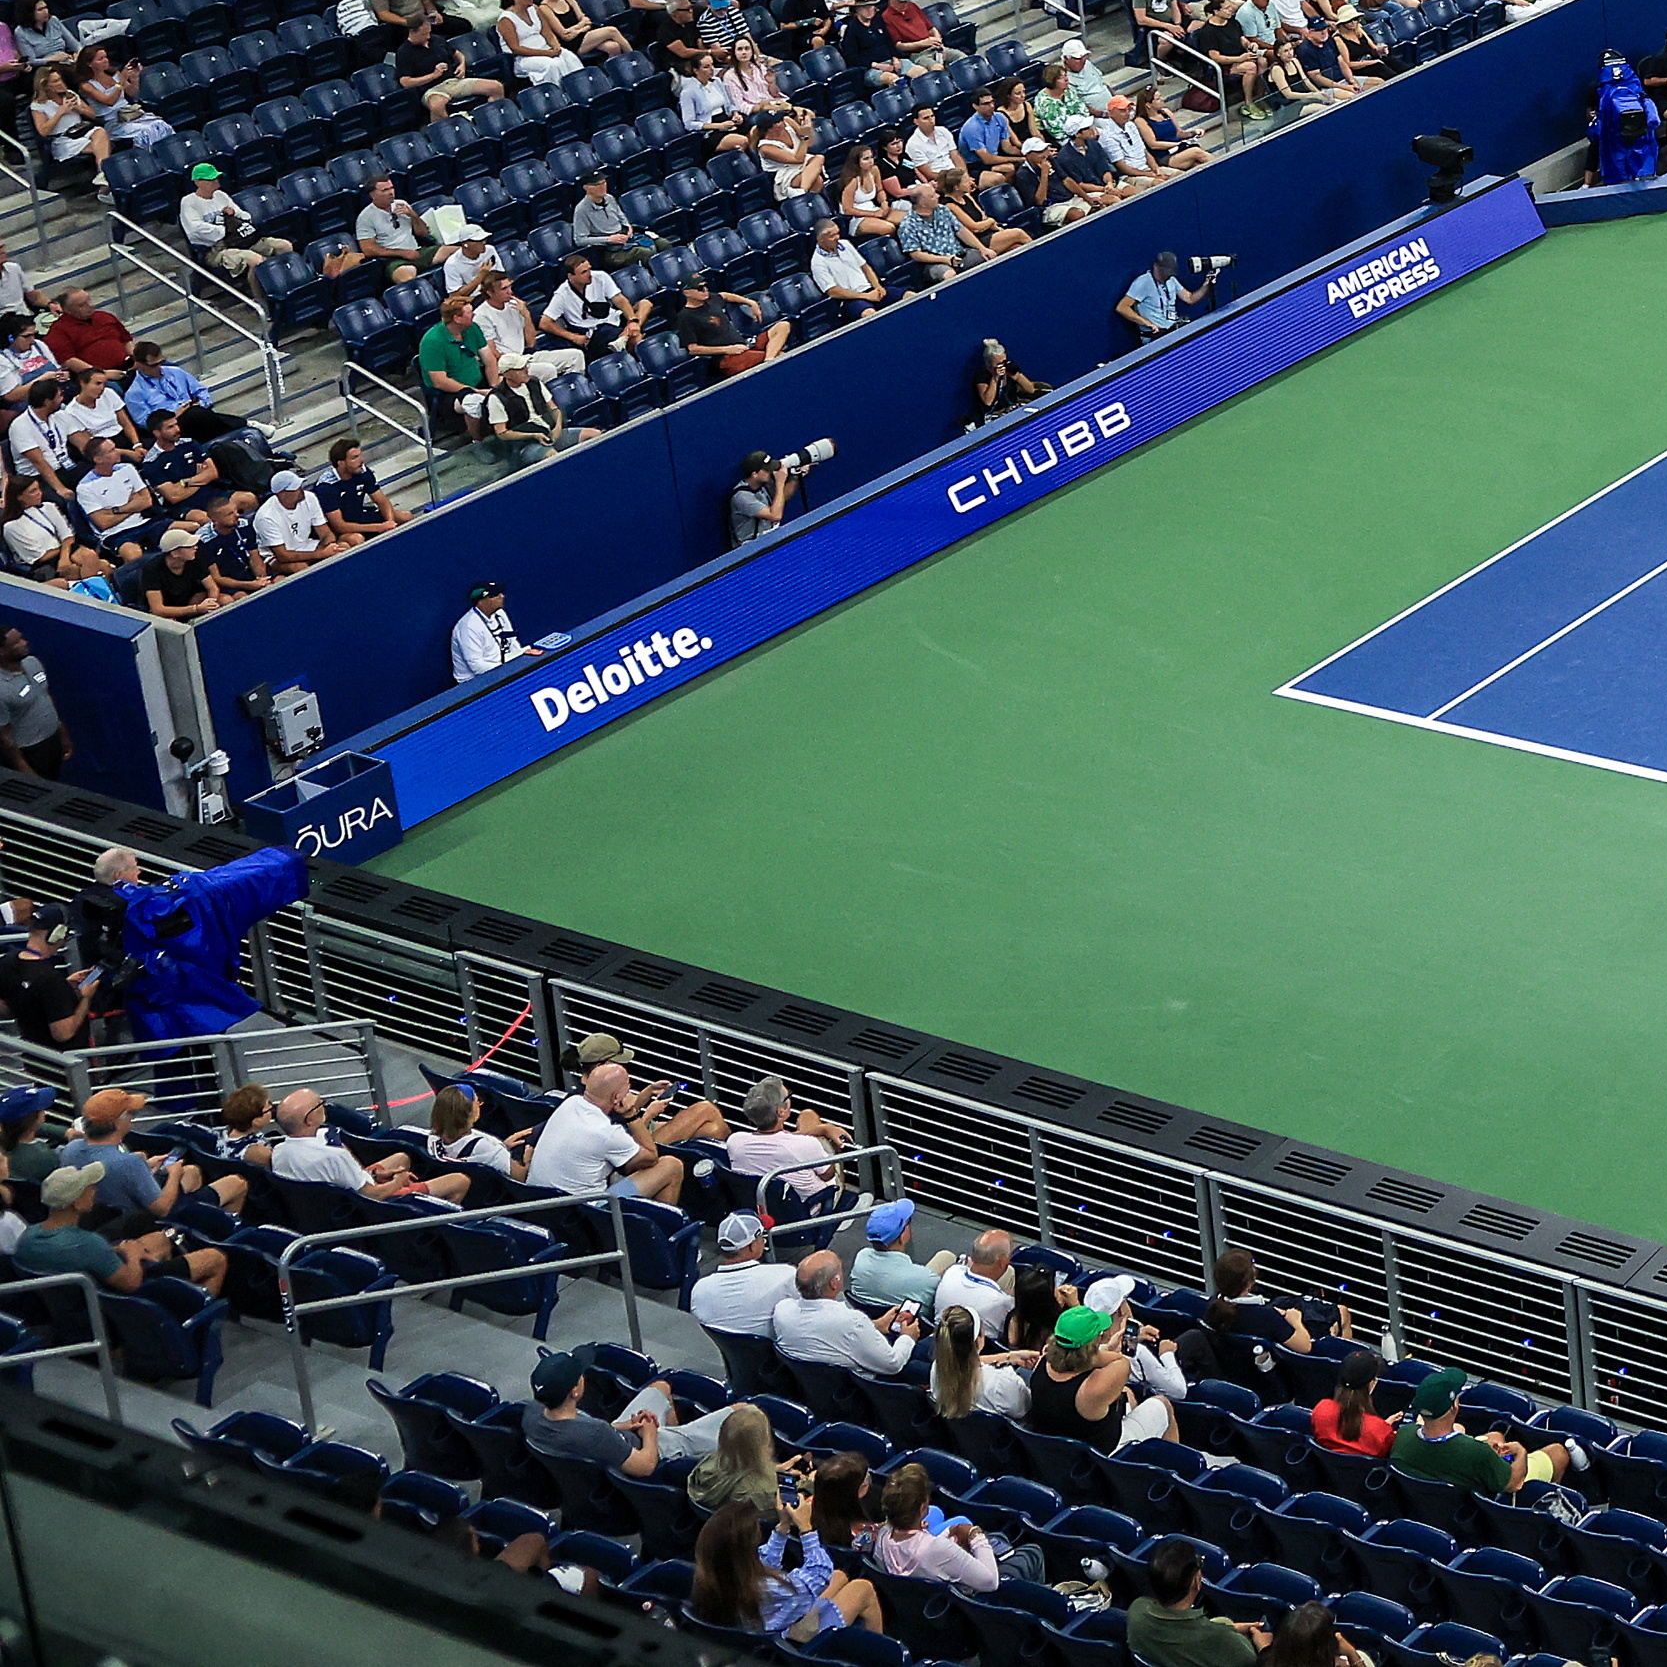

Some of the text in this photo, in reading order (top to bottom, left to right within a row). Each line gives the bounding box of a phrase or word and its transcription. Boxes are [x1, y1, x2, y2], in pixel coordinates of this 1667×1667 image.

[1326, 237, 1430, 305] AMERICAN
[1347, 257, 1441, 319] EXPRESS
[947, 401, 1131, 513] CHUBB
